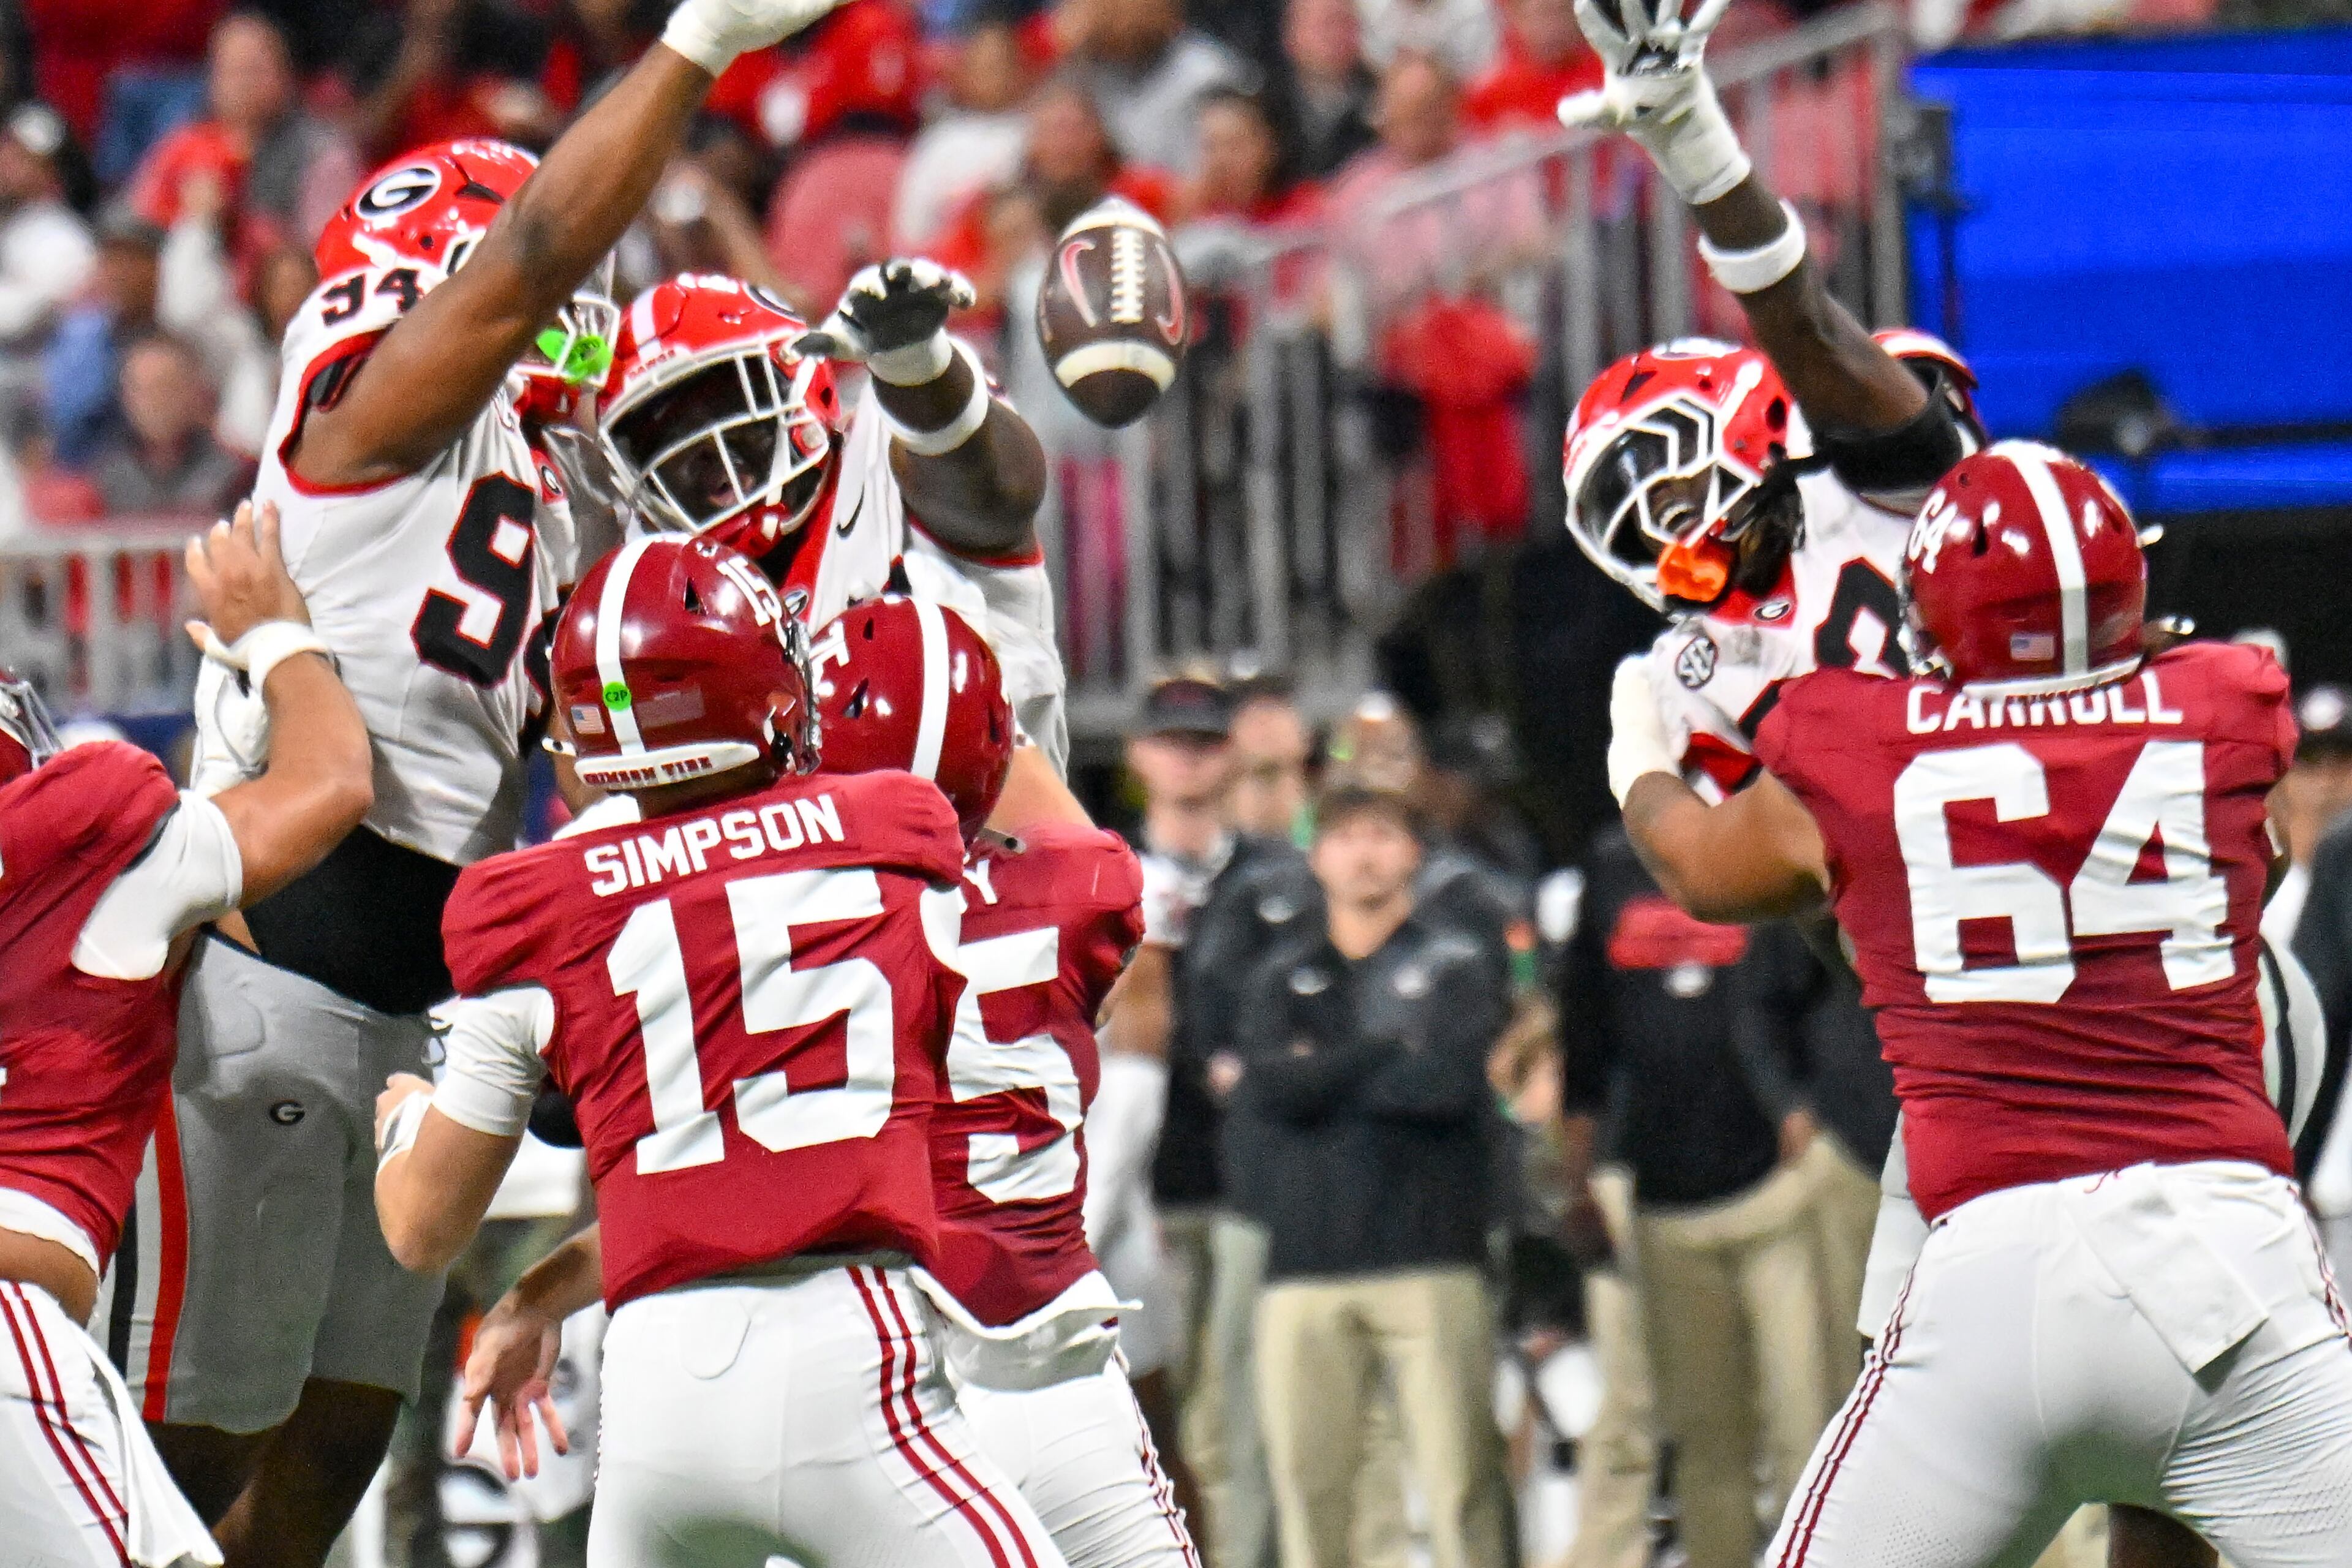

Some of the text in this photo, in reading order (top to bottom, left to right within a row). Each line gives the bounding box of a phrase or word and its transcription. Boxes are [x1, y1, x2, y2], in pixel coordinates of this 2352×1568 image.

[366, 168, 437, 211] G
[1909, 488, 1958, 574] 64
[716, 556, 783, 627] 15
[584, 794, 845, 897] SIMPSON
[1893, 739, 2235, 1003] 64
[606, 867, 895, 1175] 15
